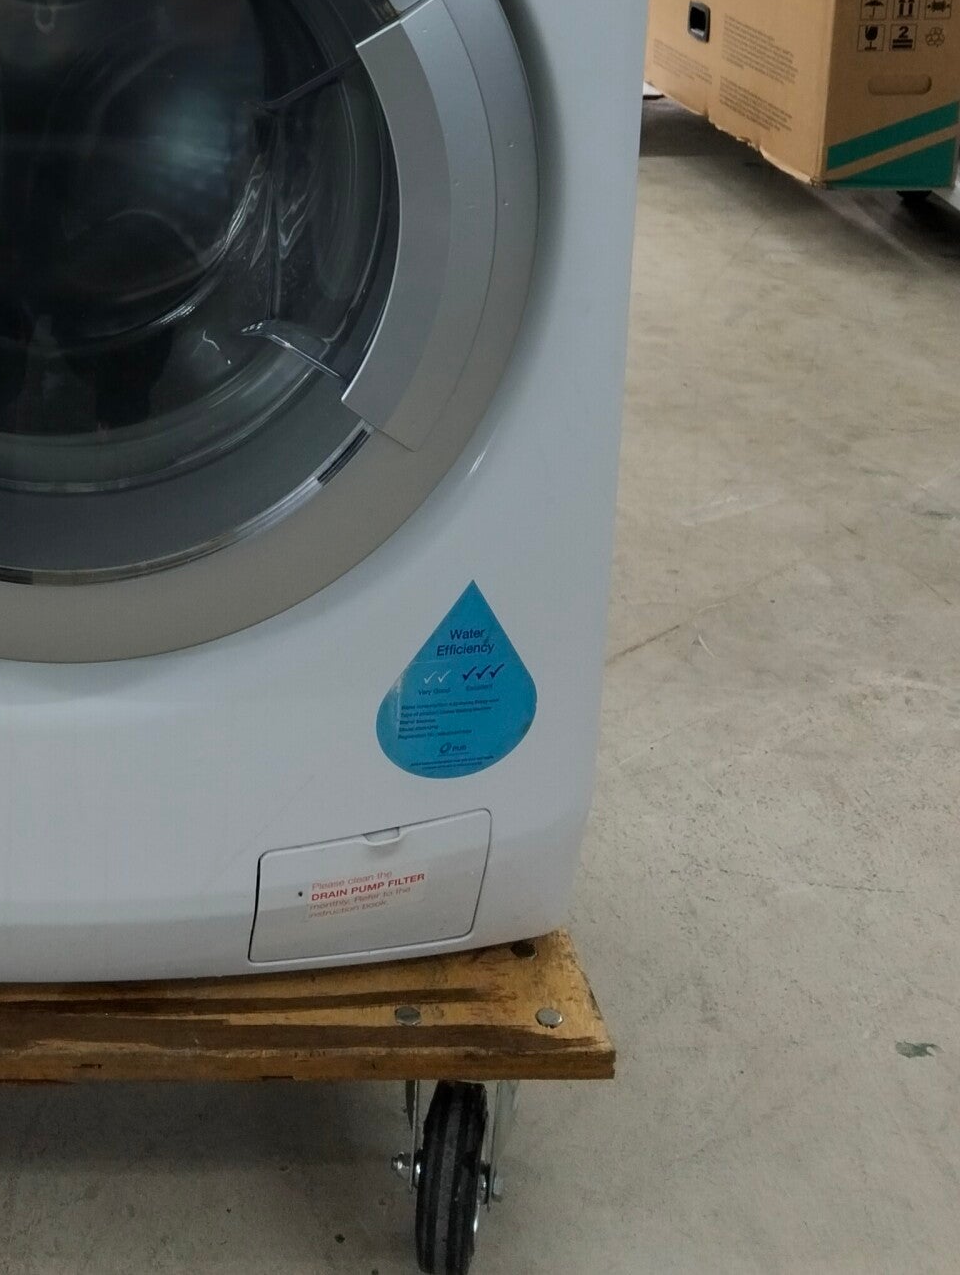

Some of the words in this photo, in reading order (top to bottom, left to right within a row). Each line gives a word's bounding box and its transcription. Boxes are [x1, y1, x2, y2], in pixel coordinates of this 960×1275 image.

[899, 26, 909, 38] 2
[450, 629, 485, 641] Water
[436, 642, 495, 657] Efficiency
[312, 879, 345, 891] Please
[347, 874, 374, 885] clean
[376, 871, 392, 880] the
[312, 888, 348, 901] DRAIN
[351, 881, 385, 895] PUMP
[388, 873, 425, 888] FILTER
